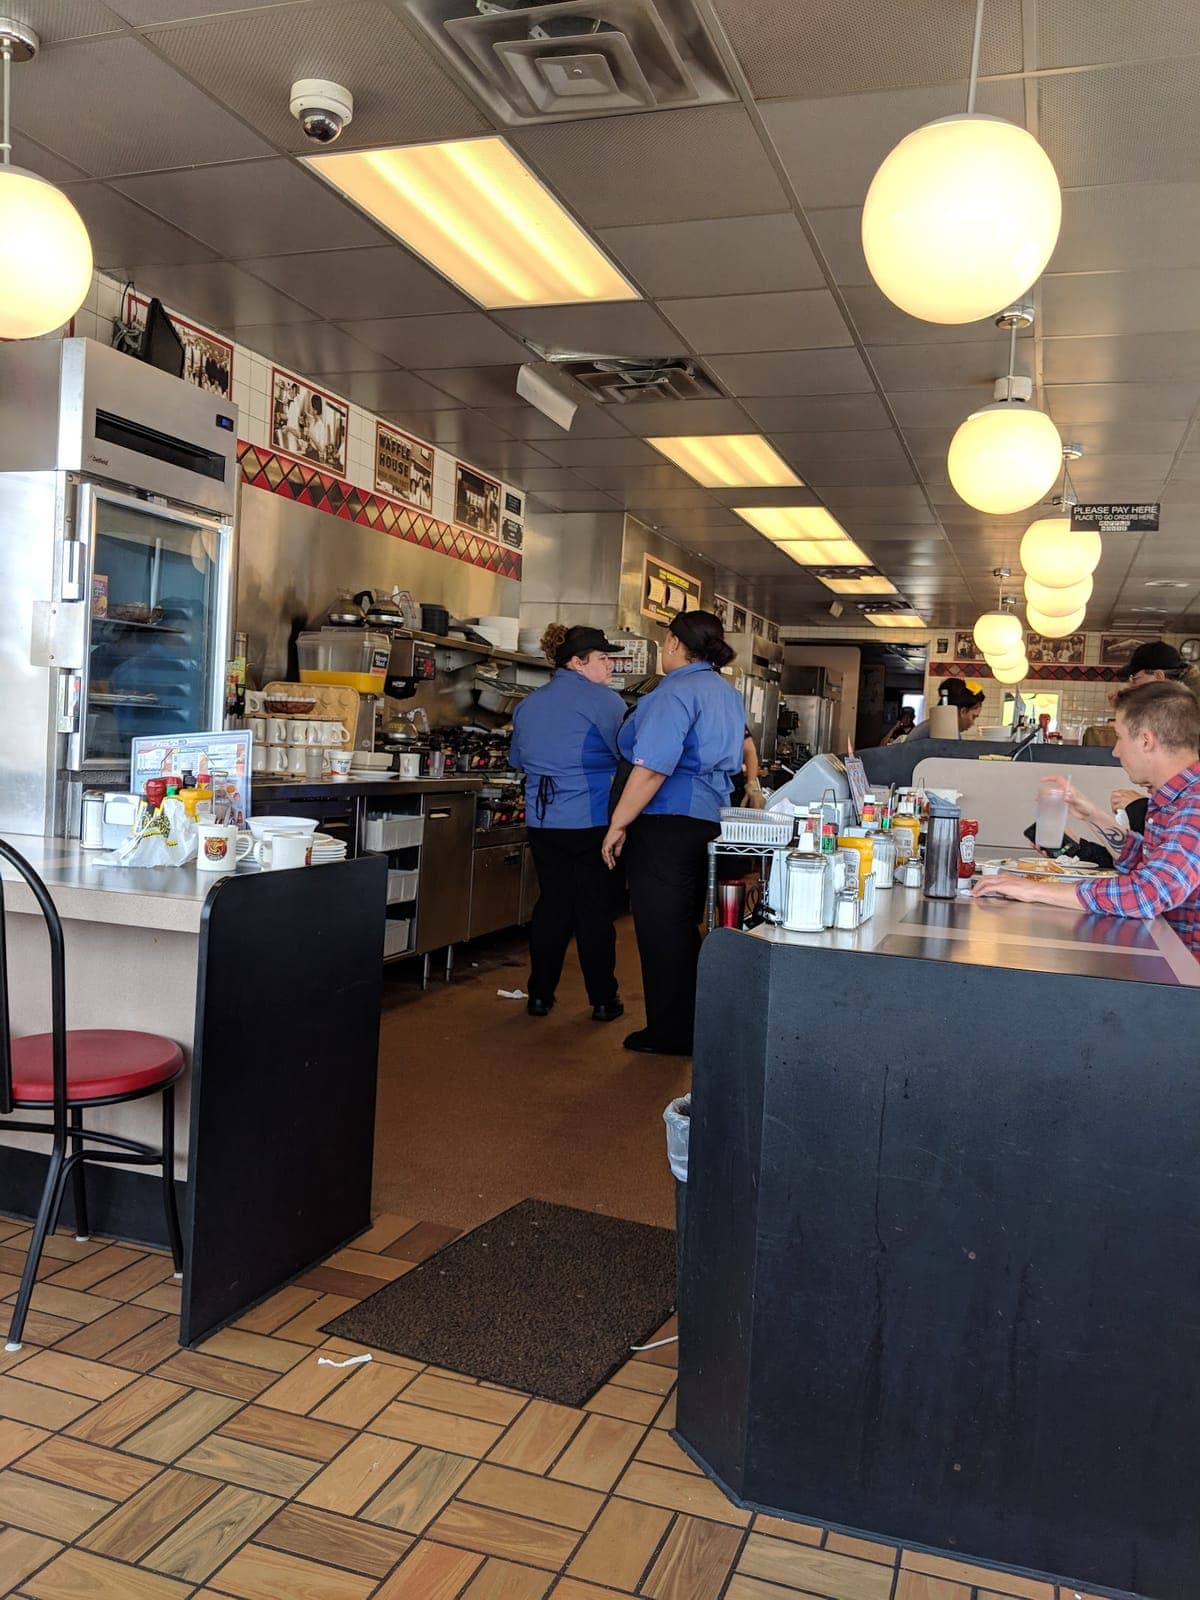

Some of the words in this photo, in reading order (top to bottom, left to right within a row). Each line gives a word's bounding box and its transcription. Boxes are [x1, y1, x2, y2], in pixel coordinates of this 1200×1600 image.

[379, 433, 410, 461] WAFFLE
[379, 452, 409, 477] HOUSE
[1073, 506, 1110, 514] PLEASE
[1111, 506, 1130, 514] PAY
[1131, 506, 1158, 514] HERE
